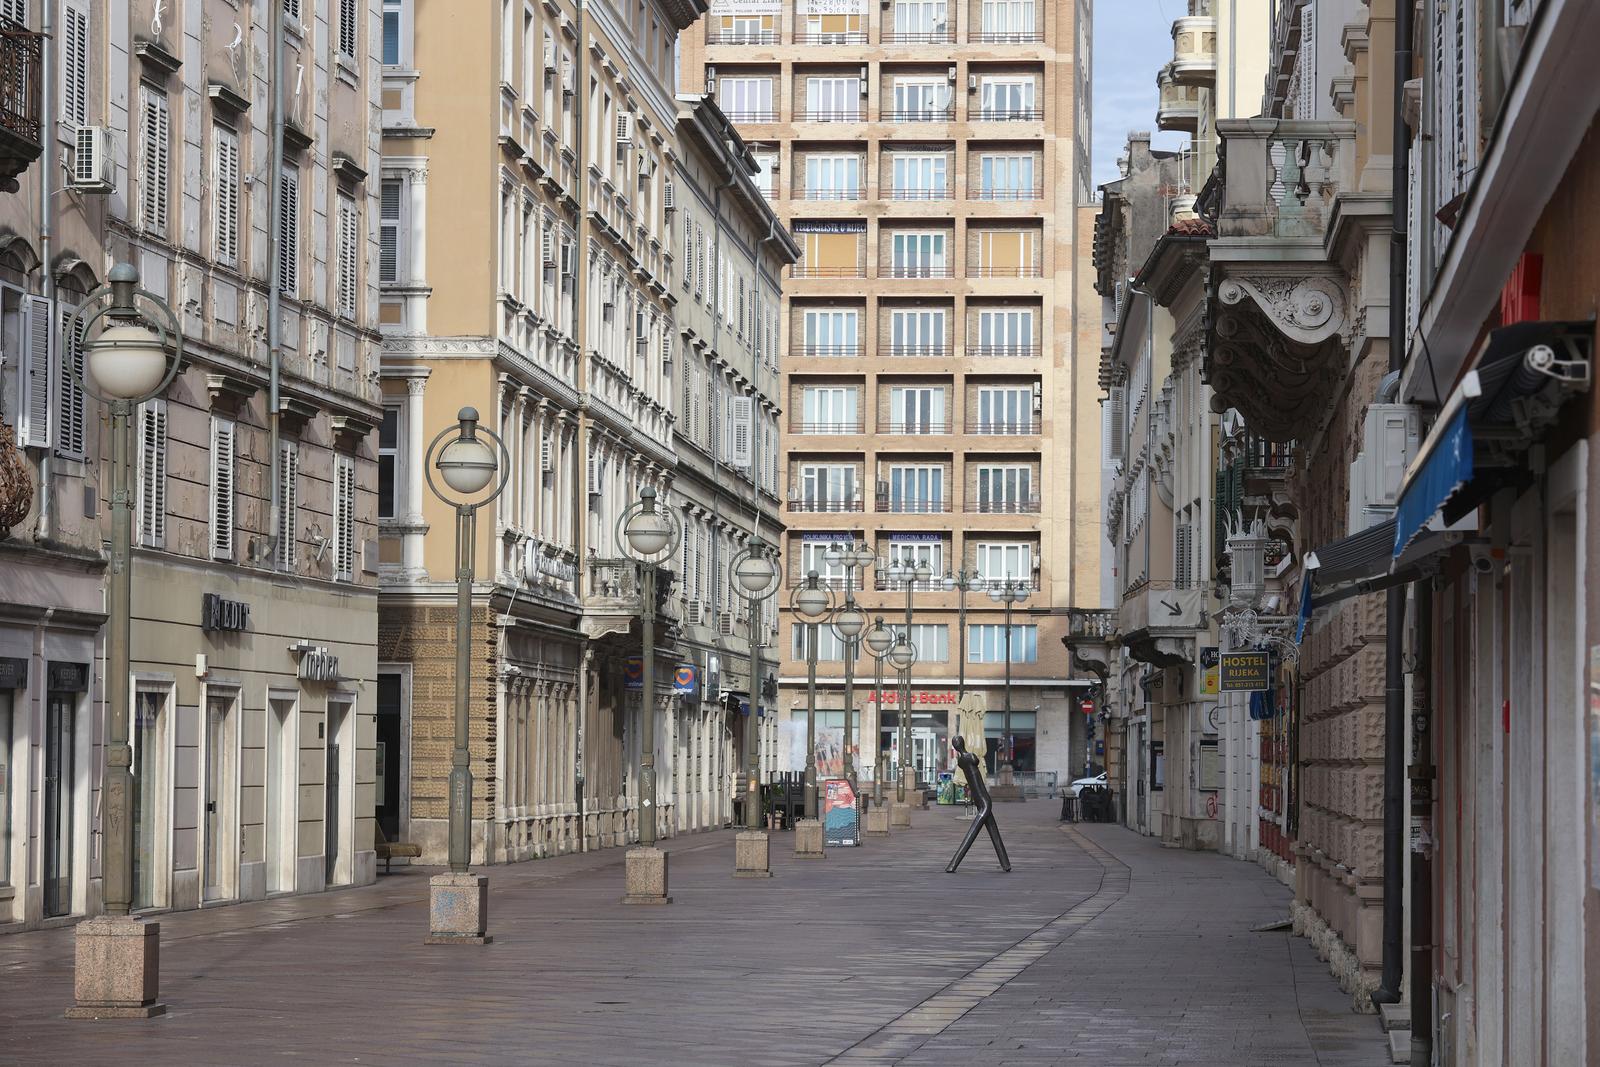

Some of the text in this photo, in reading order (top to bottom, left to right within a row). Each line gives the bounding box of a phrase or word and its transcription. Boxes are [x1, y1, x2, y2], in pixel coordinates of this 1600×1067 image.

[1223, 656, 1266, 667] HOSTEL
[1229, 669, 1260, 677] RIJEKA
[920, 690, 957, 704] Bank
